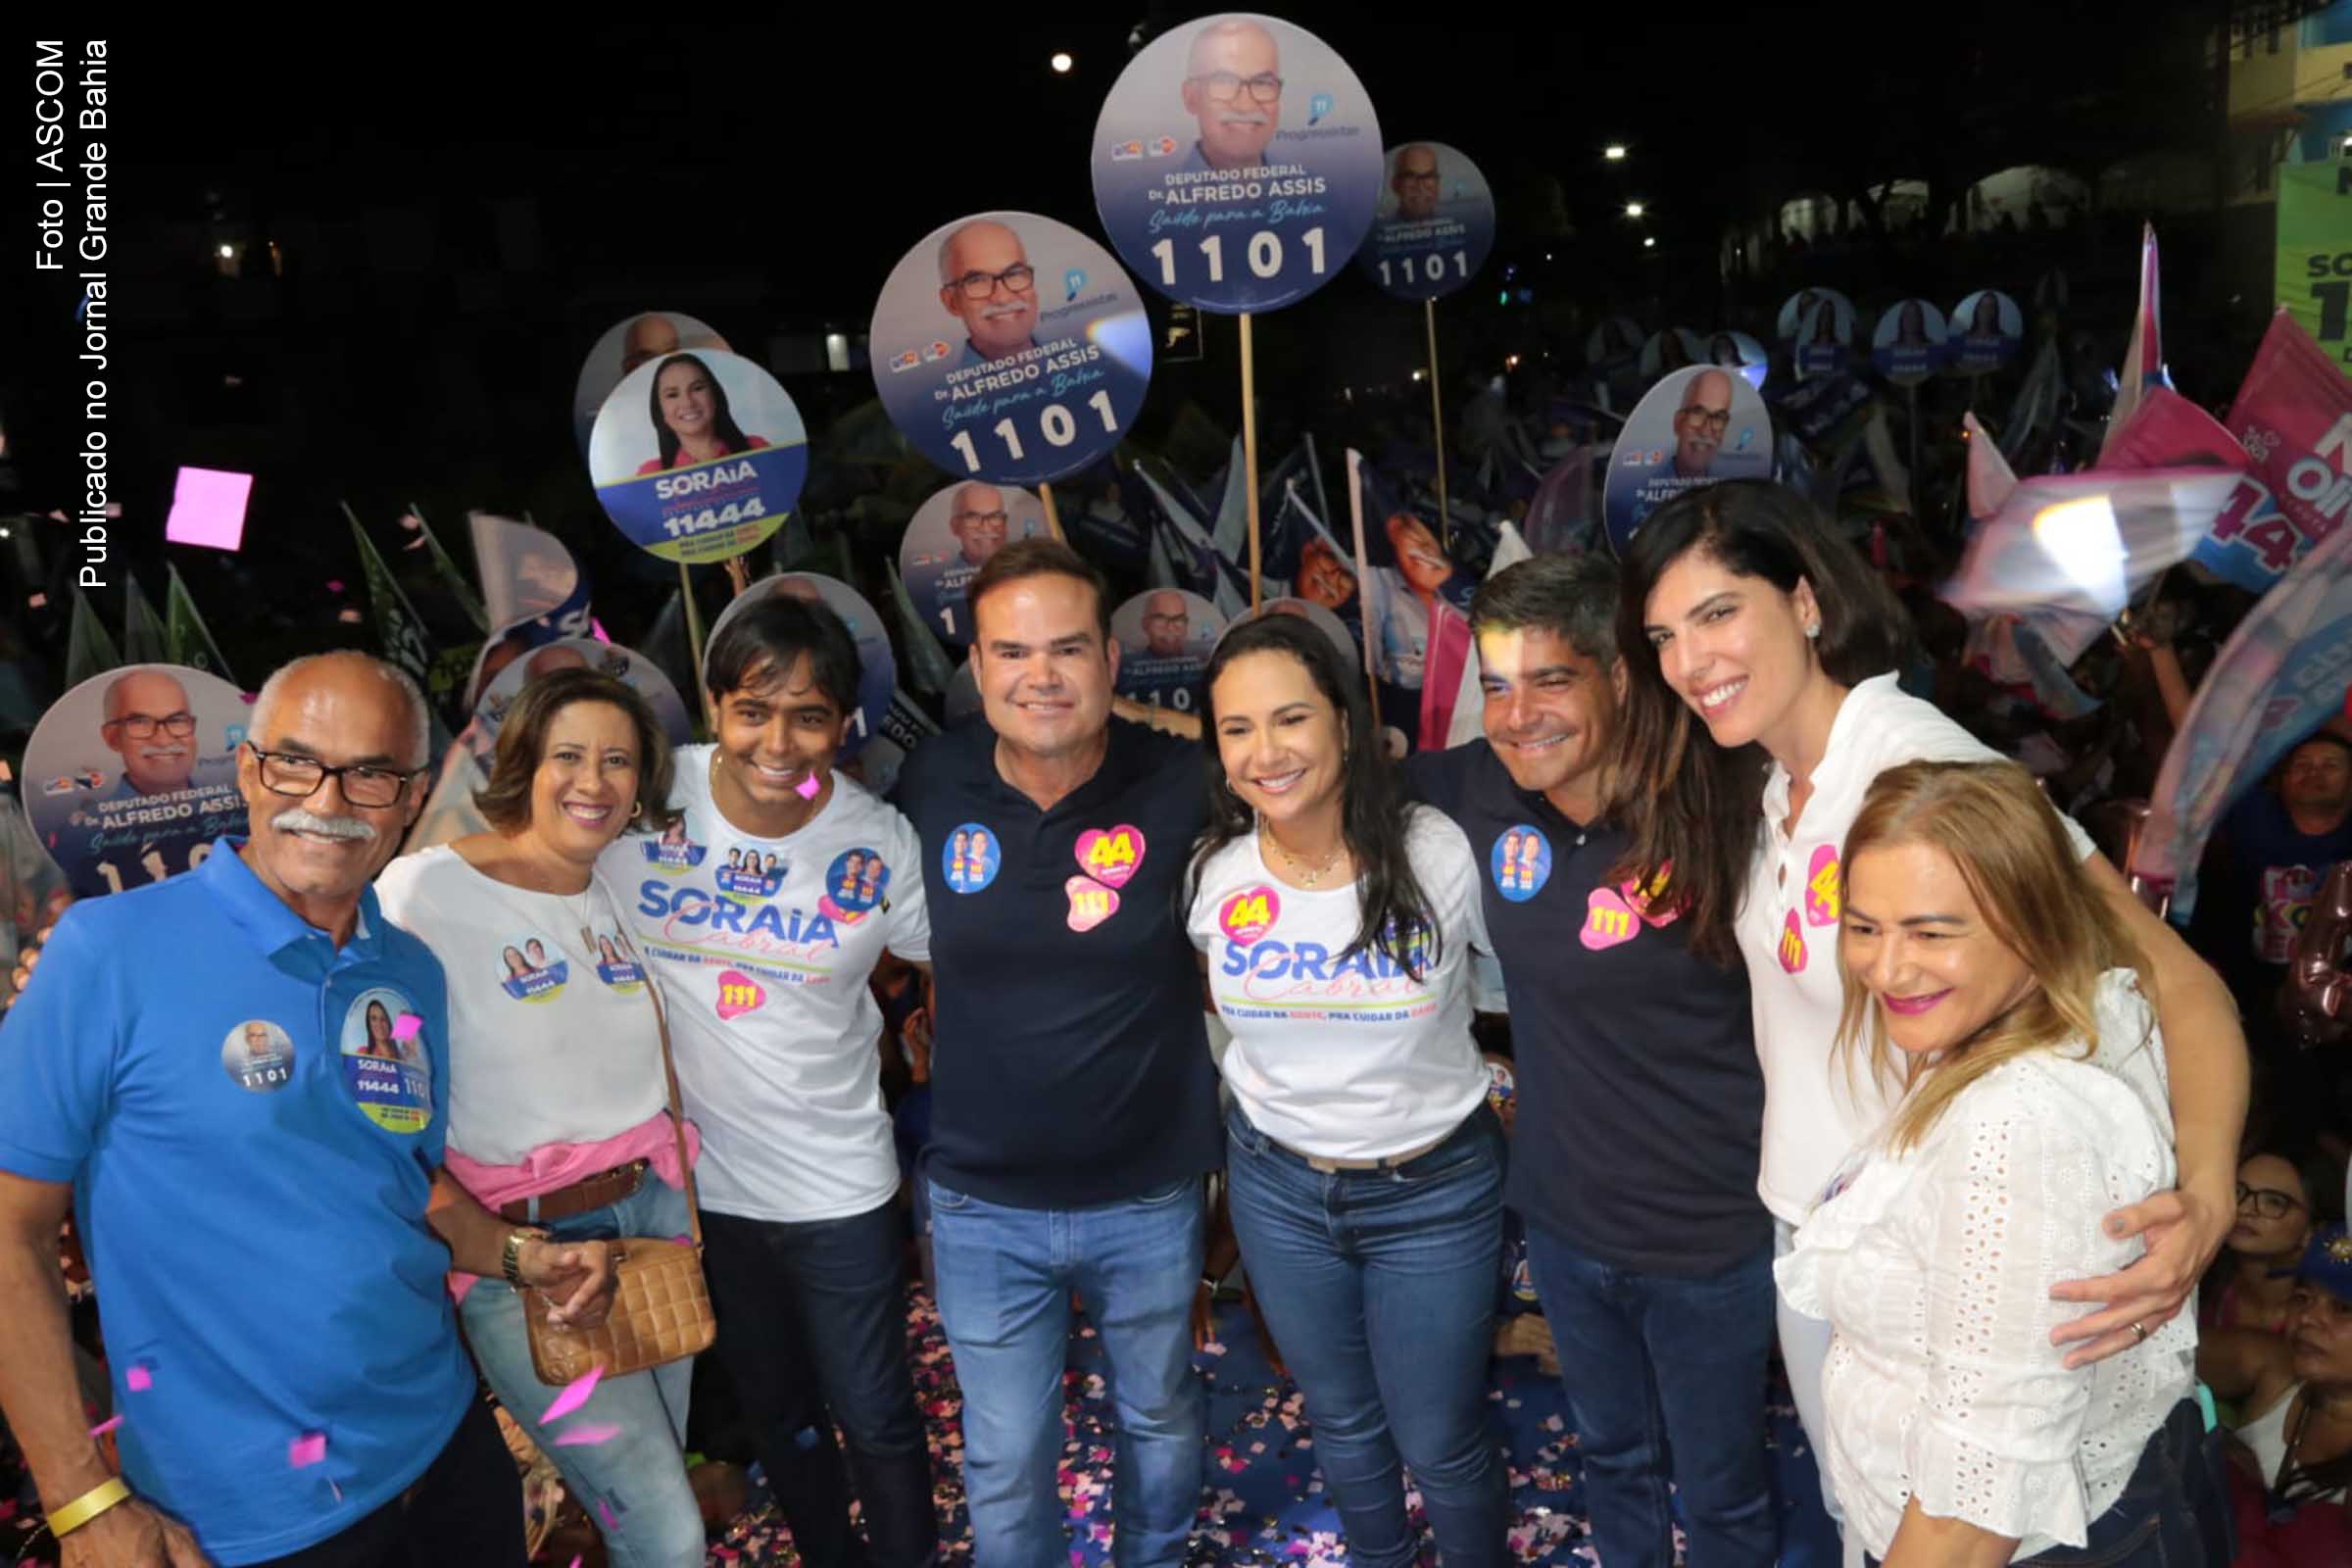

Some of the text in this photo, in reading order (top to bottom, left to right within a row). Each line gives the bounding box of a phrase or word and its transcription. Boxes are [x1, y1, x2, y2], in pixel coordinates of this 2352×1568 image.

[1164, 164, 1306, 186] DEPUTADO FEDERAL
[1165, 182, 1261, 205] ALFREDO
[1268, 176, 1326, 198] ASSIS
[1268, 198, 1326, 225] Bahia
[1152, 226, 1326, 285] 1101
[1379, 250, 1468, 286] 1101
[946, 355, 1016, 386] DEPUTADO
[1017, 336, 1077, 362] FEDERAL
[952, 363, 1041, 402] ALFREDO
[1046, 344, 1102, 374] ASSIS
[1051, 367, 1105, 399] Bahia
[950, 389, 1118, 473] 1101
[663, 497, 766, 538] 11444
[98, 784, 231, 812] DEPUTADO FEDERAL
[102, 803, 193, 831] ALFREDO
[199, 795, 248, 814] ASSI
[1089, 831, 1137, 868] 44
[1073, 891, 1110, 917] 111
[1228, 893, 1271, 929] 44
[1591, 906, 1632, 938] 111
[722, 983, 759, 1008] 111
[1237, 1007, 1272, 1020] CUIDAR
[1328, 1010, 1350, 1021] PRA
[1352, 1009, 1394, 1022] CUIDAR
[242, 1066, 288, 1088] 1101
